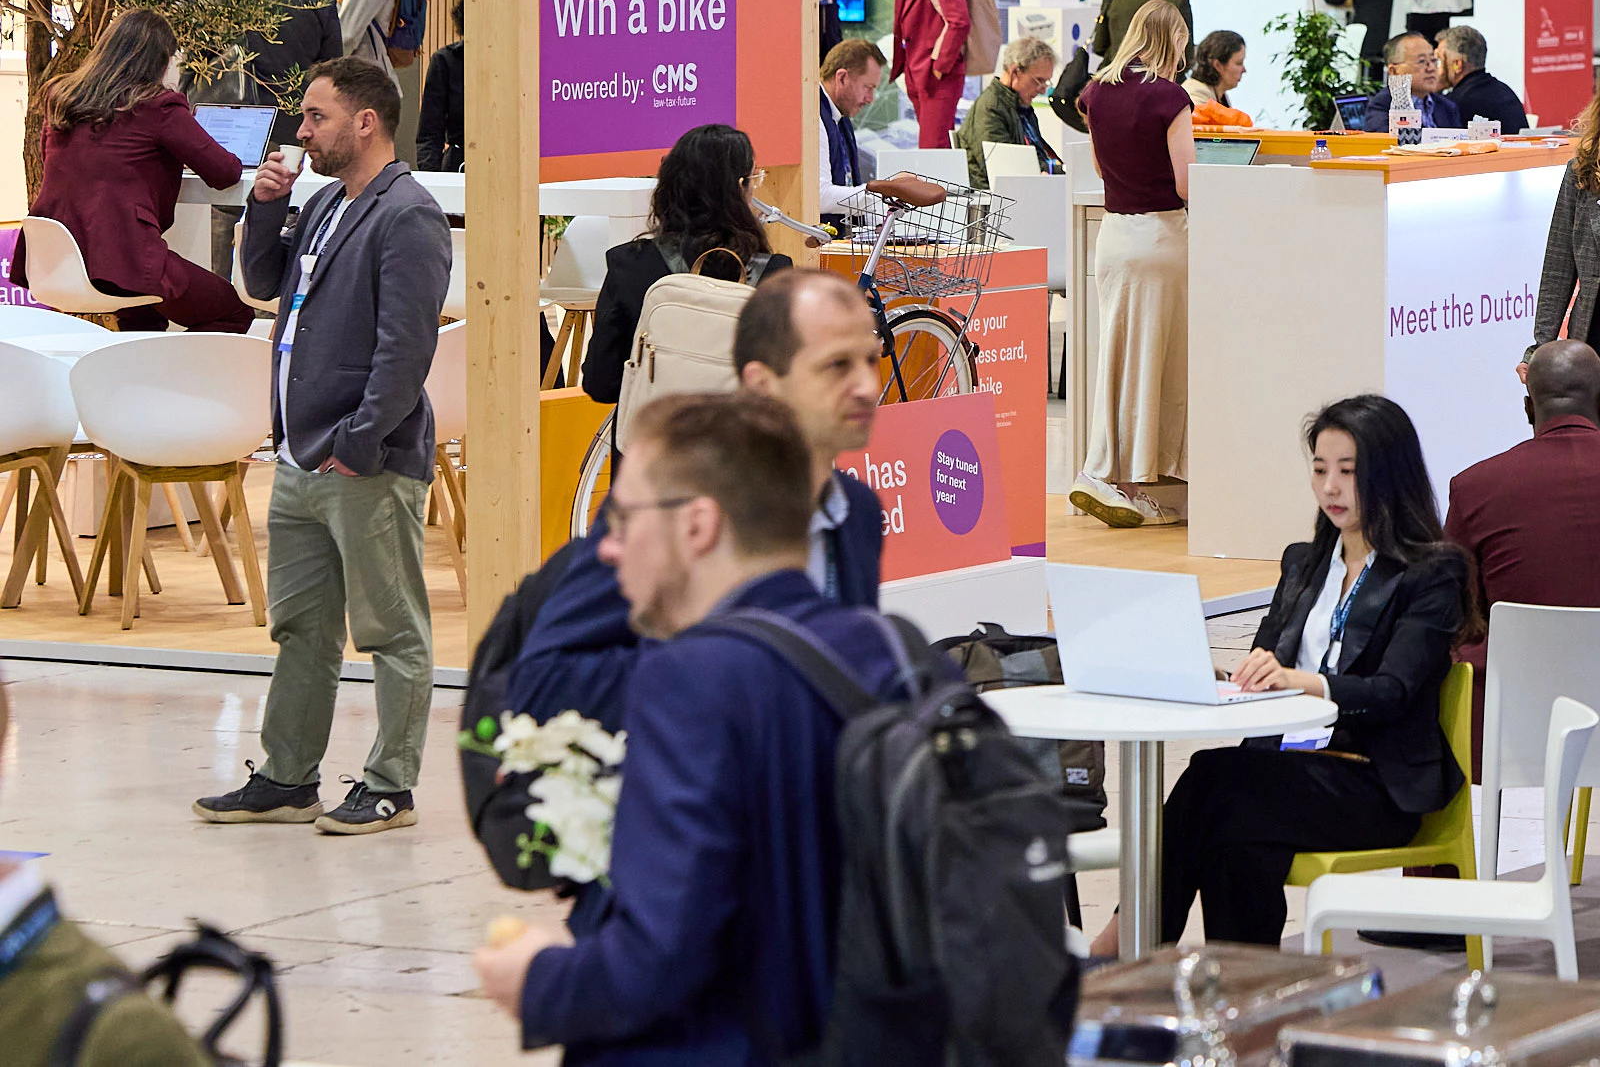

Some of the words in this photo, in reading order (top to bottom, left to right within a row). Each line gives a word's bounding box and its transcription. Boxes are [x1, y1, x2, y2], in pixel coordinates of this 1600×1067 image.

[552, 72, 617, 101] Powered
[622, 72, 645, 104] by:
[652, 62, 698, 93] CMS
[1390, 300, 1437, 337] Meet
[1442, 293, 1473, 329] the
[1481, 283, 1534, 324] Dutch
[983, 315, 1008, 336] your
[1000, 340, 1027, 363] card,
[980, 376, 1003, 395] bike
[865, 453, 907, 490] has
[937, 451, 954, 469] Stay
[956, 456, 979, 476] tuned
[936, 469, 949, 484] for
[949, 477, 967, 491] next
[936, 488, 956, 505] year!
